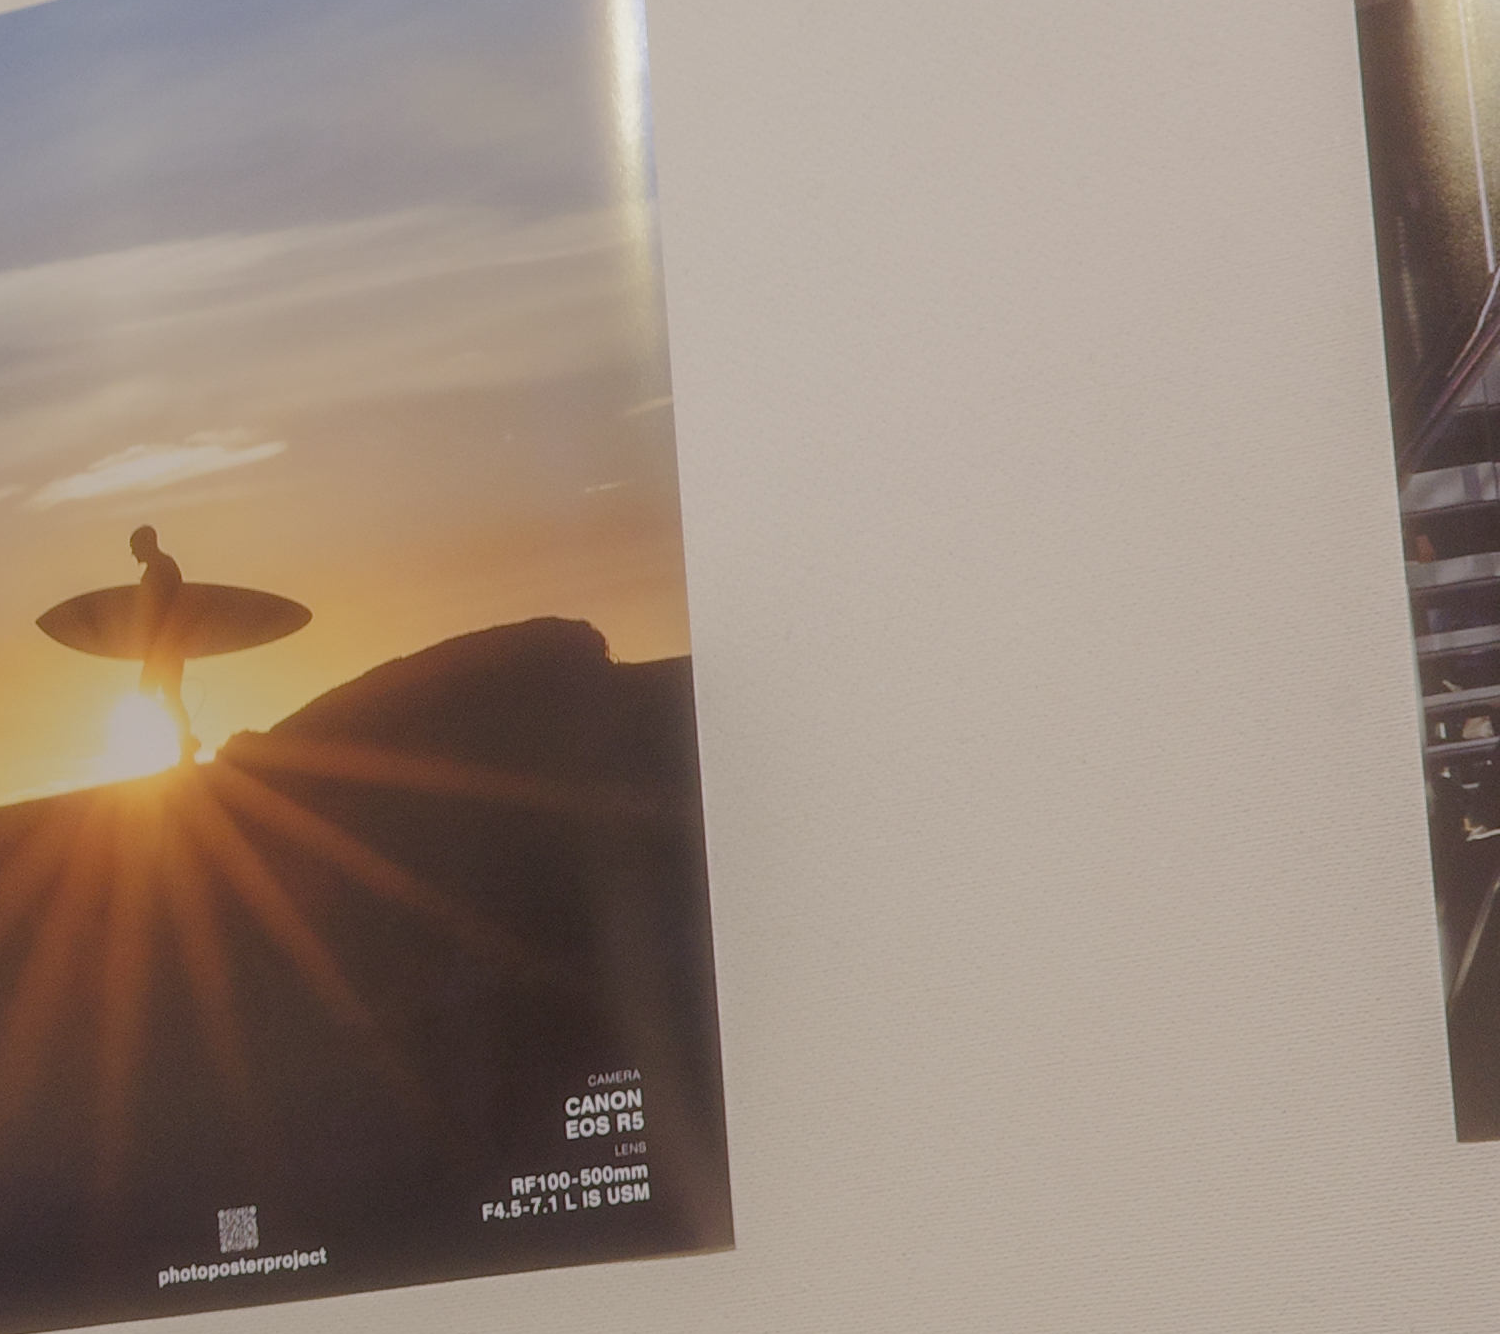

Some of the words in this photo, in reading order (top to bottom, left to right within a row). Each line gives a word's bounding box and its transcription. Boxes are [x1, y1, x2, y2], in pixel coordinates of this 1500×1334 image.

[587, 1068, 641, 1088] CAMERA
[564, 1088, 643, 1117] CANON
[565, 1115, 610, 1140] EOS
[616, 1110, 645, 1133] R5
[614, 1140, 647, 1157] LENS
[510, 1163, 649, 1196] RF100-500mm
[481, 1194, 558, 1222] F4.5-7.1
[564, 1192, 578, 1211] L
[582, 1188, 601, 1209] IS
[606, 1181, 650, 1206] USM
[158, 1246, 328, 1289] photoposterproject
